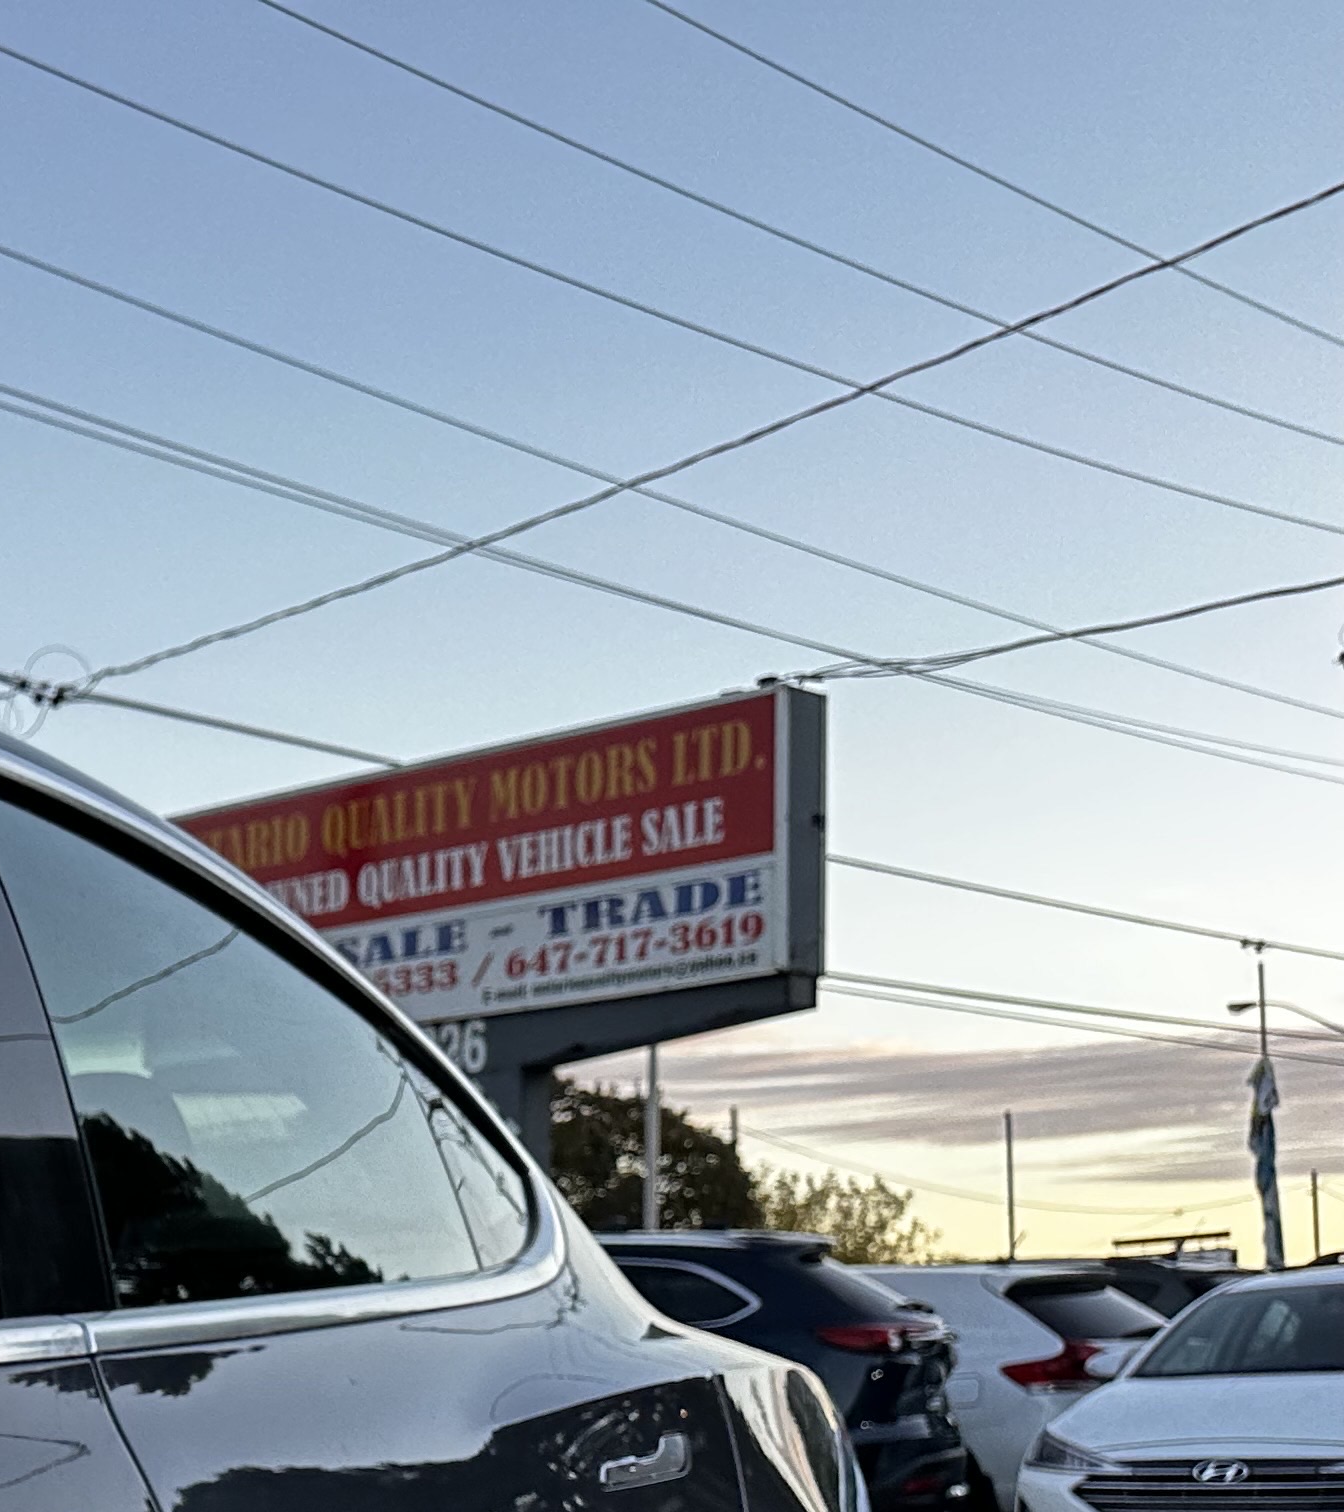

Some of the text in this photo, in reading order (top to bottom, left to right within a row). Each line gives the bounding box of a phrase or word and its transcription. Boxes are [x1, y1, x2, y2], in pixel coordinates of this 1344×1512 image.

[321, 776, 477, 857] QUALITY
[489, 737, 658, 823] MOTORS
[672, 719, 767, 787] LTD.
[358, 841, 488, 909] QUALITY
[496, 814, 633, 882] VEHICLE
[640, 796, 726, 856] SALE
[504, 911, 766, 980] 647-717-3619
[537, 869, 764, 939] TRADE
